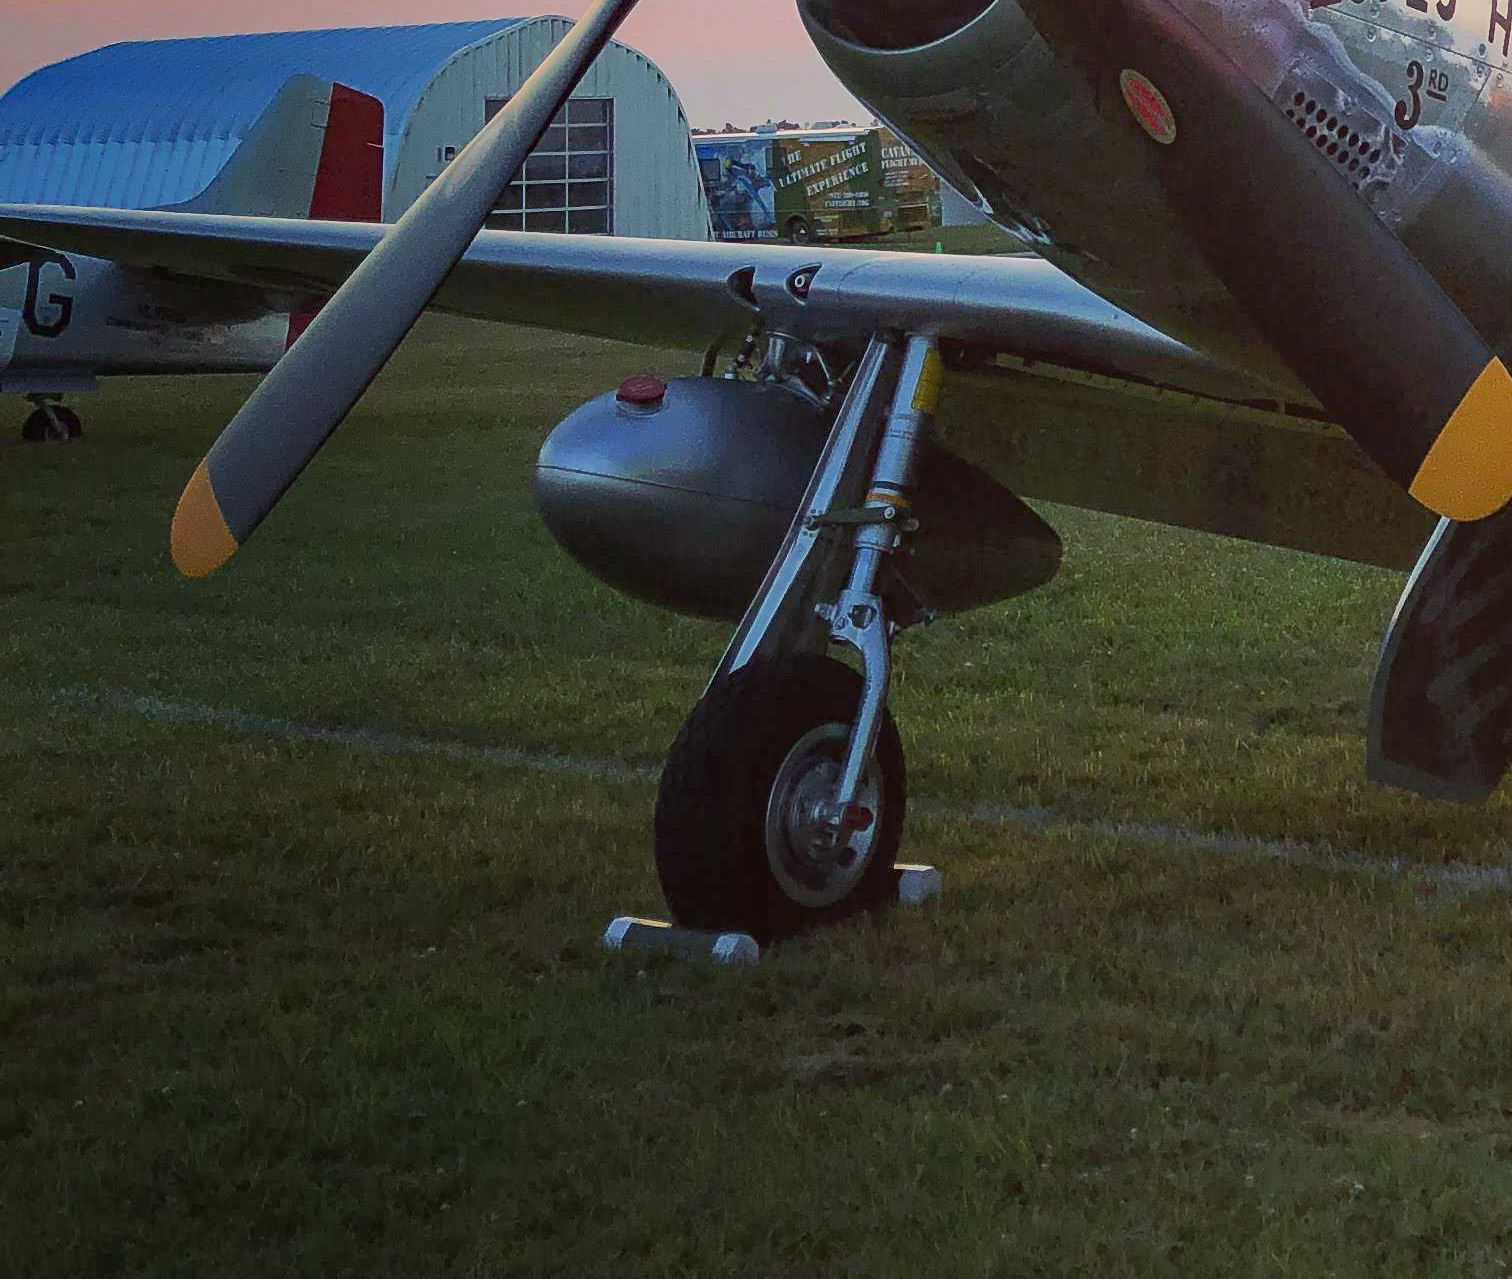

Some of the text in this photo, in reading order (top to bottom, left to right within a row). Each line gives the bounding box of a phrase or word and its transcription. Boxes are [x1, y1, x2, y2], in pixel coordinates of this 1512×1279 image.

[778, 141, 866, 188] ULTIMATE FLIGHT
[806, 161, 869, 197] EXPERIENCE
[22, 253, 76, 339] G
